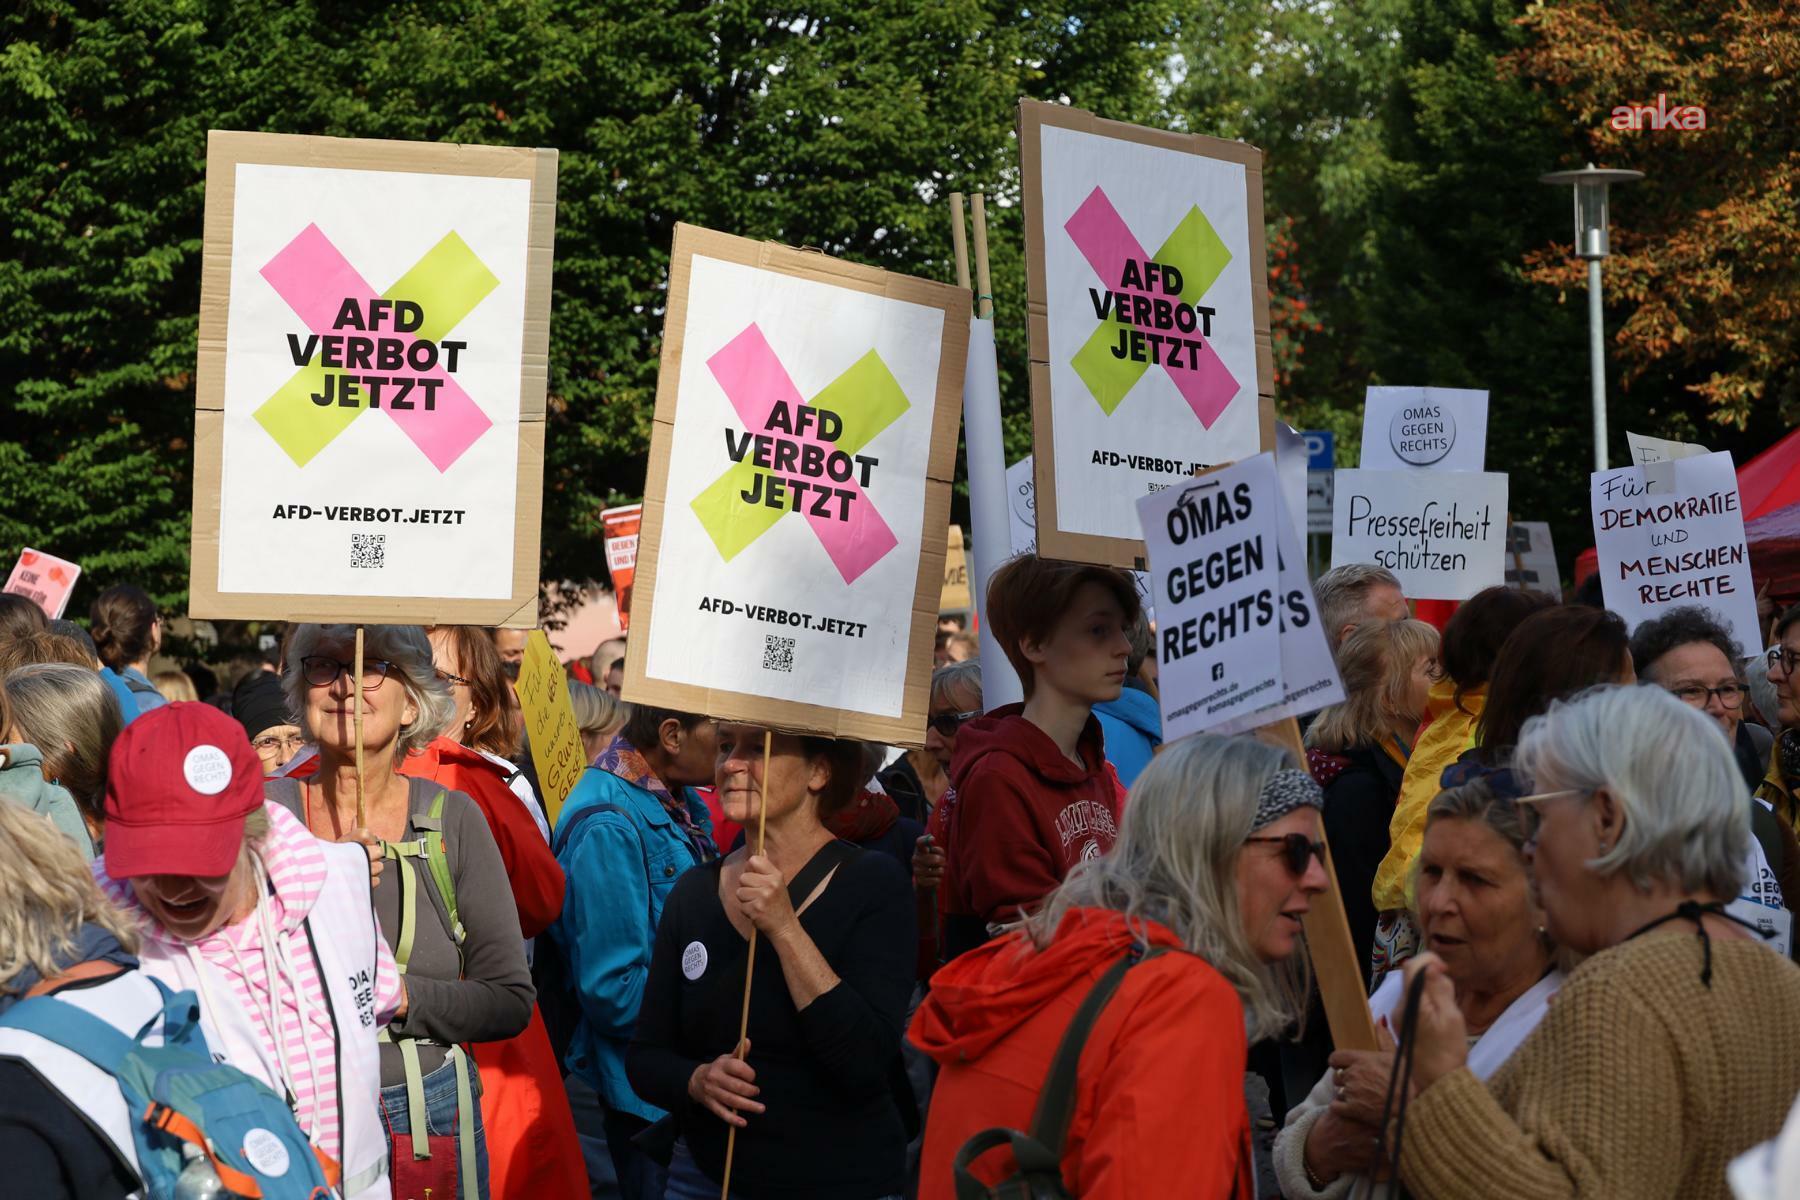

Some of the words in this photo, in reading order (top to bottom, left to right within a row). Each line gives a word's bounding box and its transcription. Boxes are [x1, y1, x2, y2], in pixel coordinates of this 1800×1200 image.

[1120, 259, 1183, 295] AFD
[332, 298, 424, 333] AFD
[1089, 288, 1215, 337] VERBOT
[287, 333, 467, 373] VERBOT
[1110, 329, 1202, 371] JETZT
[311, 375, 444, 411] JETZT
[1403, 406, 1441, 420] OMAS
[764, 400, 843, 442] AFD
[1401, 422, 1444, 436] GEGEN
[725, 428, 879, 488] VERBOT
[1400, 437, 1448, 453] RECHTS
[740, 474, 857, 522] JETZT
[1600, 475, 1656, 501] Für
[273, 504, 466, 525] AFD-VERBOT.JETZT
[1167, 482, 1253, 545] OMAS
[1349, 495, 1490, 546] Pressefreiheit
[1600, 491, 1737, 531] DEMOKRATIE
[1374, 539, 1466, 570] schützen
[1651, 529, 1689, 547] UND
[1167, 535, 1264, 604] GEGEN
[1638, 575, 1735, 604] RECHTE
[699, 596, 867, 638] AFD-VERBOT.JETZT
[1163, 589, 1273, 664] RECHTS
